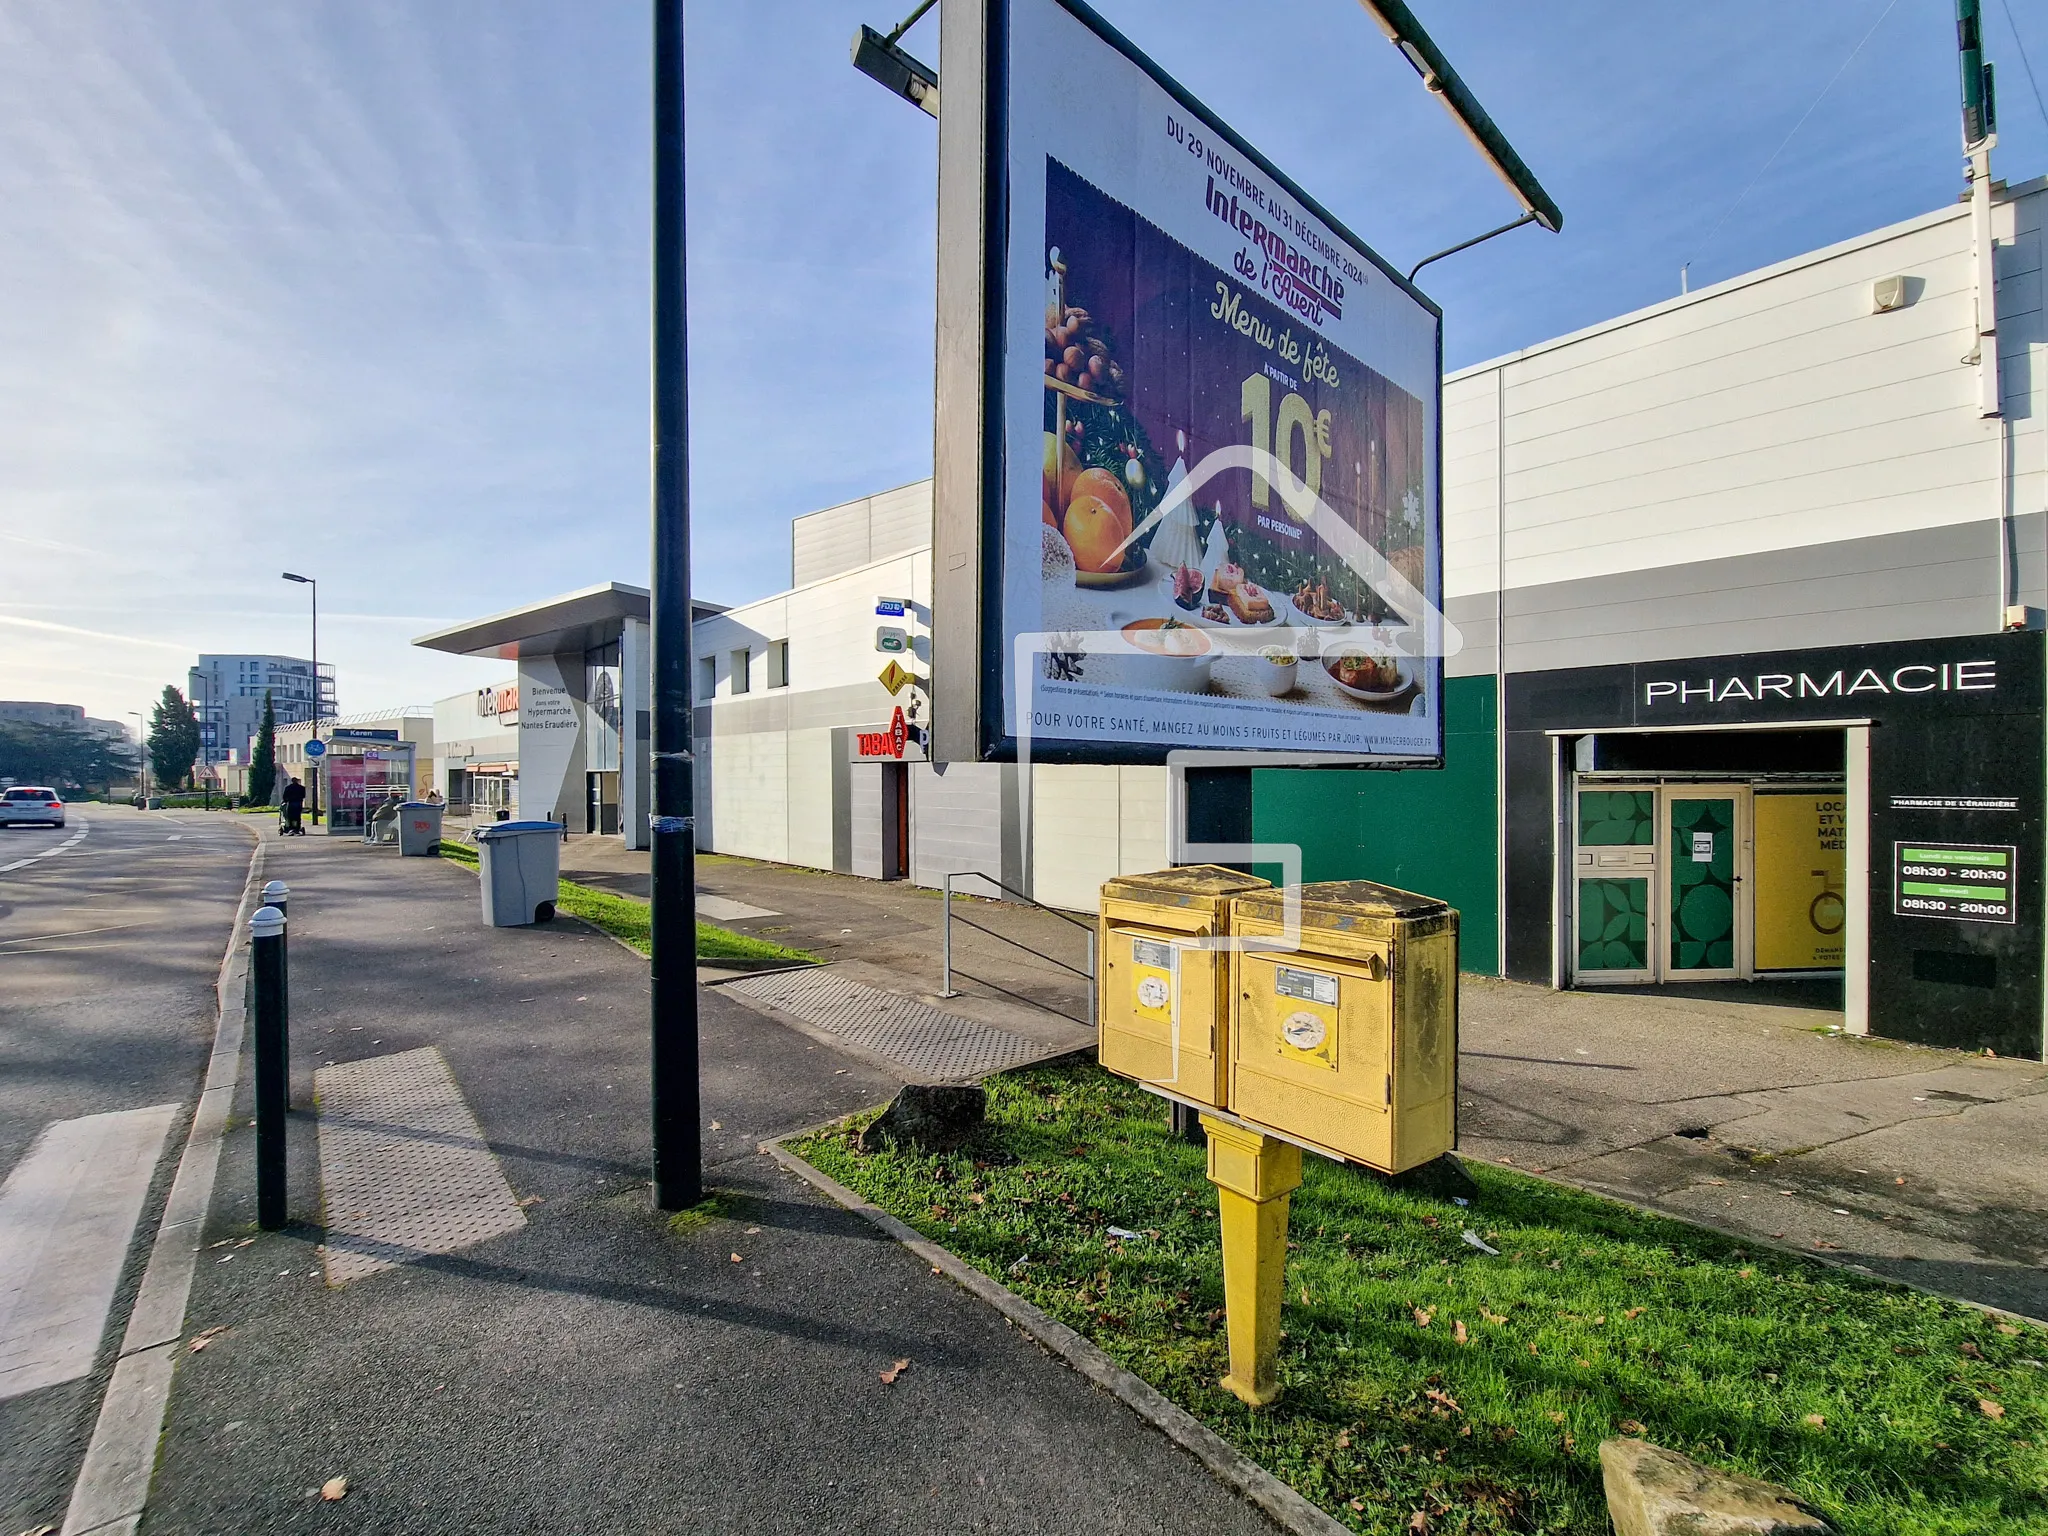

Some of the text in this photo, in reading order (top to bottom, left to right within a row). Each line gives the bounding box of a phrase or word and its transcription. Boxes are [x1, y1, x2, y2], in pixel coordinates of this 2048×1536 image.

[1167, 115, 1184, 144] DU
[1188, 133, 1203, 158] 29
[1206, 147, 1265, 210] NOVEMBRE
[1268, 199, 1281, 221] AU
[1283, 210, 1292, 231] 31
[1295, 219, 1341, 269] DÉCEMBRE
[1205, 174, 1345, 308] Intermarché
[1233, 246, 1323, 327] de l'Avent
[1210, 280, 1340, 388] Menu de fête
[1289, 377, 1298, 391] DE
[1257, 514, 1270, 529] PAR
[880, 602, 894, 610] FDJ
[1646, 660, 1996, 706] PHARMACIE
[532, 687, 566, 696] Bienvenue
[527, 706, 571, 718] Hypermarché
[521, 721, 544, 730] Nantes
[1026, 712, 1061, 727] POUR
[1067, 714, 1105, 730] VOTRE
[1111, 717, 1148, 733] SANTÉ,
[1153, 720, 1193, 735] MANGEZ
[1197, 723, 1209, 736] AU
[1213, 724, 1240, 738] MOINS
[1244, 726, 1249, 738] 5
[1252, 727, 1280, 740] FRUITS
[1283, 729, 1291, 740] ET
[1294, 729, 1325, 742] LÉGUMES
[1329, 732, 1341, 743] PAR
[350, 729, 373, 737] Keren
[1893, 799, 1943, 807] PHARMACIE
[1960, 799, 2017, 808] L'ÉRAUDIÈRE
[1819, 814, 1835, 825] ET
[1954, 854, 1990, 862] vendredi
[1902, 866, 1947, 877] 08h30
[1960, 869, 2007, 881] 20h30
[1938, 887, 1969, 895] Samedi
[1902, 898, 1947, 910] 08h30
[1959, 902, 2007, 915] 20h00
